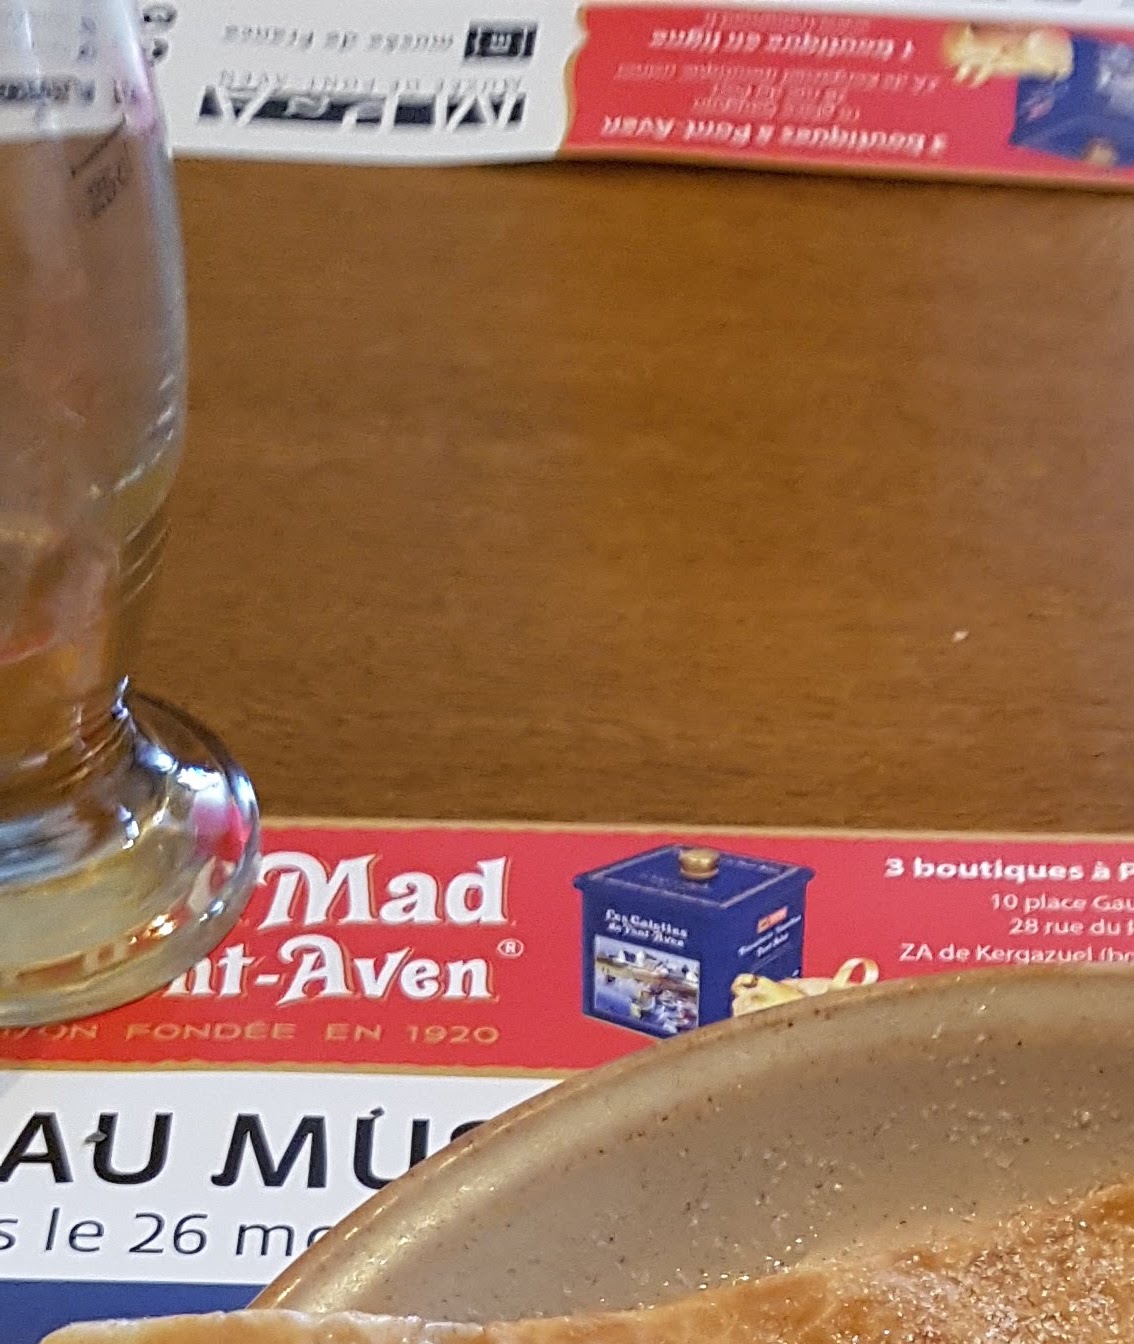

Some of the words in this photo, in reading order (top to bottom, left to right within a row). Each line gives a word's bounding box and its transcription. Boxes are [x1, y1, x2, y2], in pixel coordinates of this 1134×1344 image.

[884, 858, 904, 878] 3
[914, 857, 1085, 884] boutiques
[1092, 861, 1111, 881] à
[256, 850, 508, 931] Mad
[991, 893, 1018, 911] 10
[1025, 894, 1087, 914] place
[1009, 917, 1039, 936] 28
[1045, 920, 1084, 937] rue
[1091, 918, 1121, 937] du
[900, 943, 933, 962] ZA
[939, 944, 970, 962] de
[163, 934, 500, 1007] nt-Aven
[126, 1020, 298, 1042] FONDÉE
[324, 1022, 384, 1042] EN
[407, 1023, 501, 1044] 1920
[0, 1111, 173, 1185] AU
[210, 1112, 492, 1190] MU
[44, 1207, 104, 1253] le
[128, 1212, 209, 1256] 26
